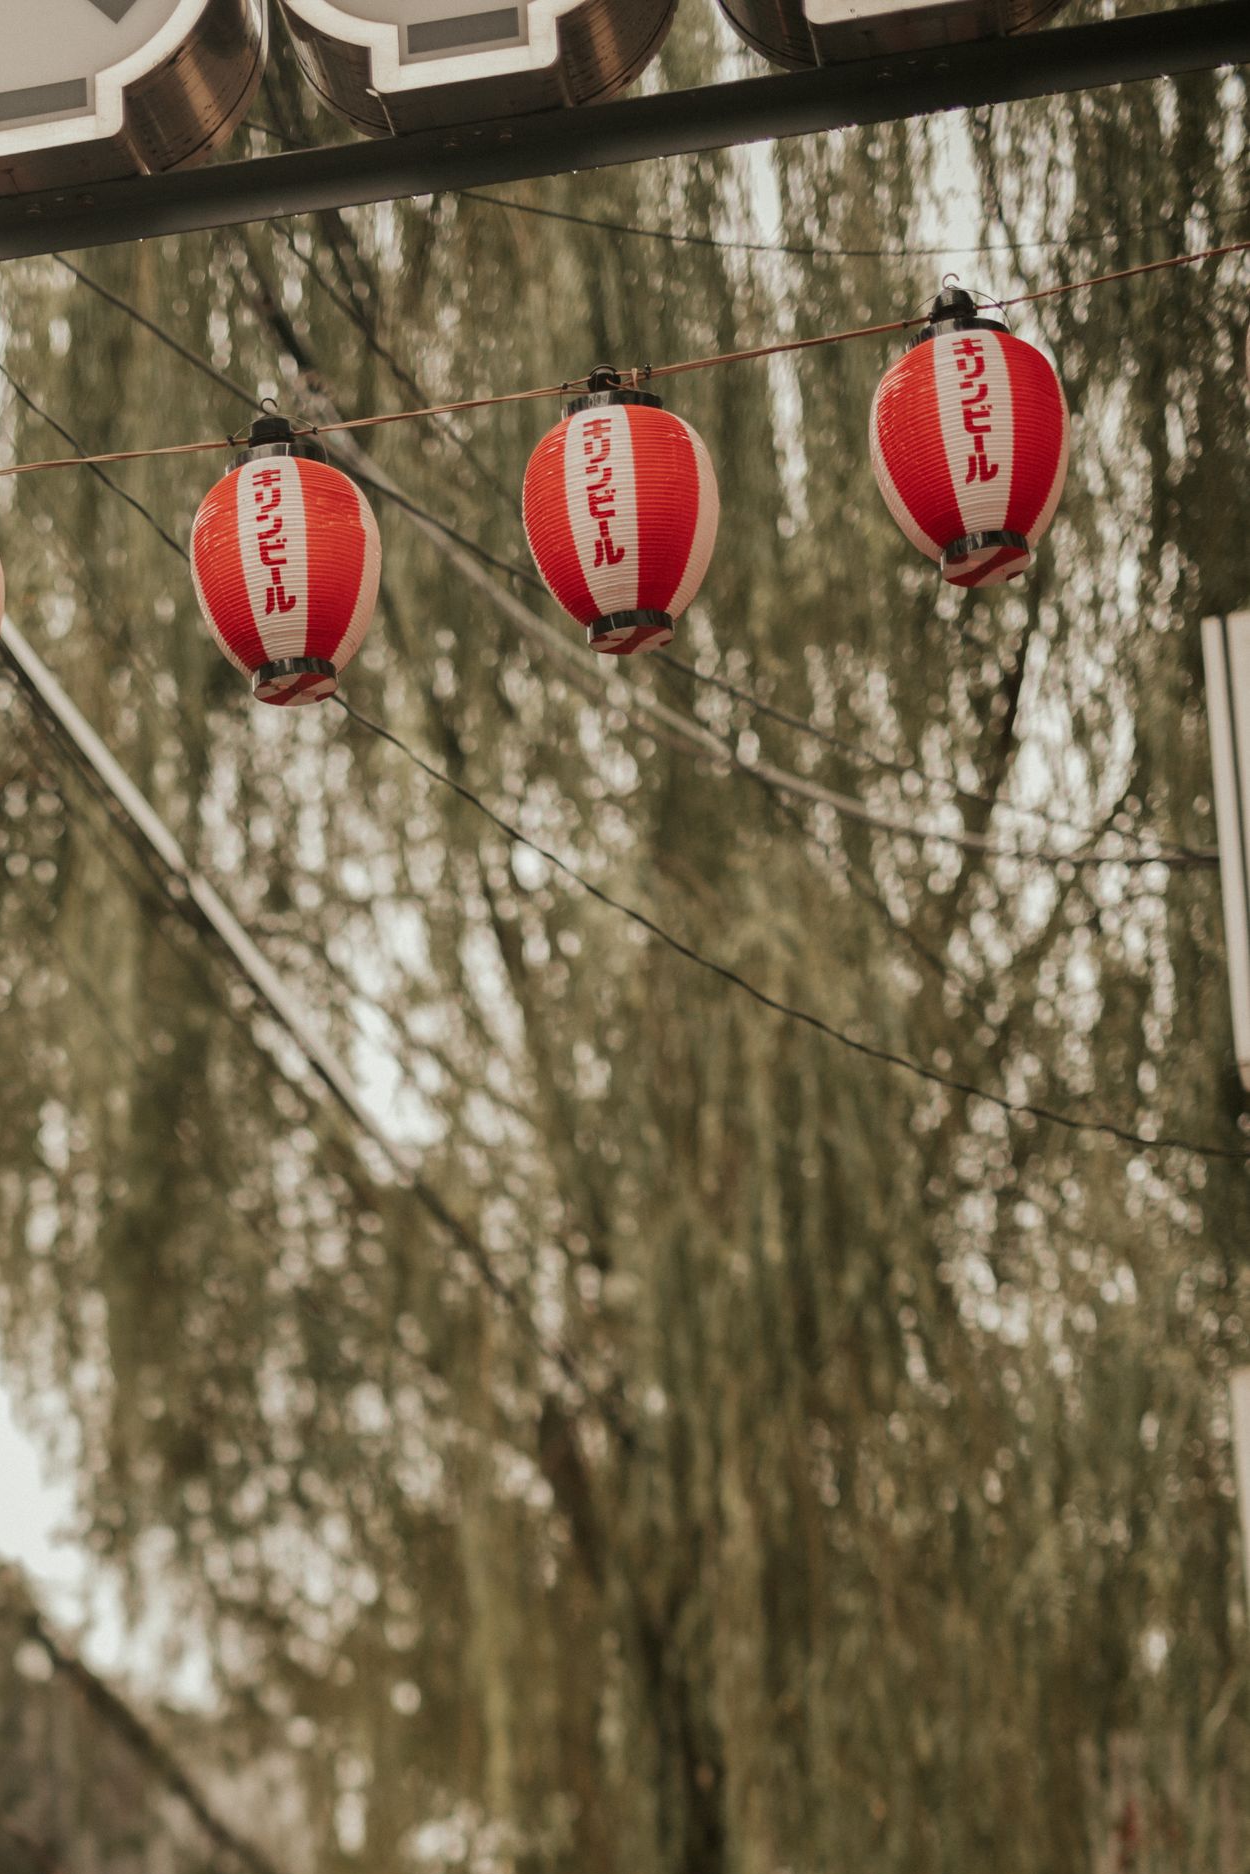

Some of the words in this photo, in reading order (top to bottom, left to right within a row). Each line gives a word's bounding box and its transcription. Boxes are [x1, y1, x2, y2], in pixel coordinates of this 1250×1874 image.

[952, 338, 999, 485] キリンビール
[253, 468, 297, 615] キリンビール
[583, 418, 626, 568] キリンビール
